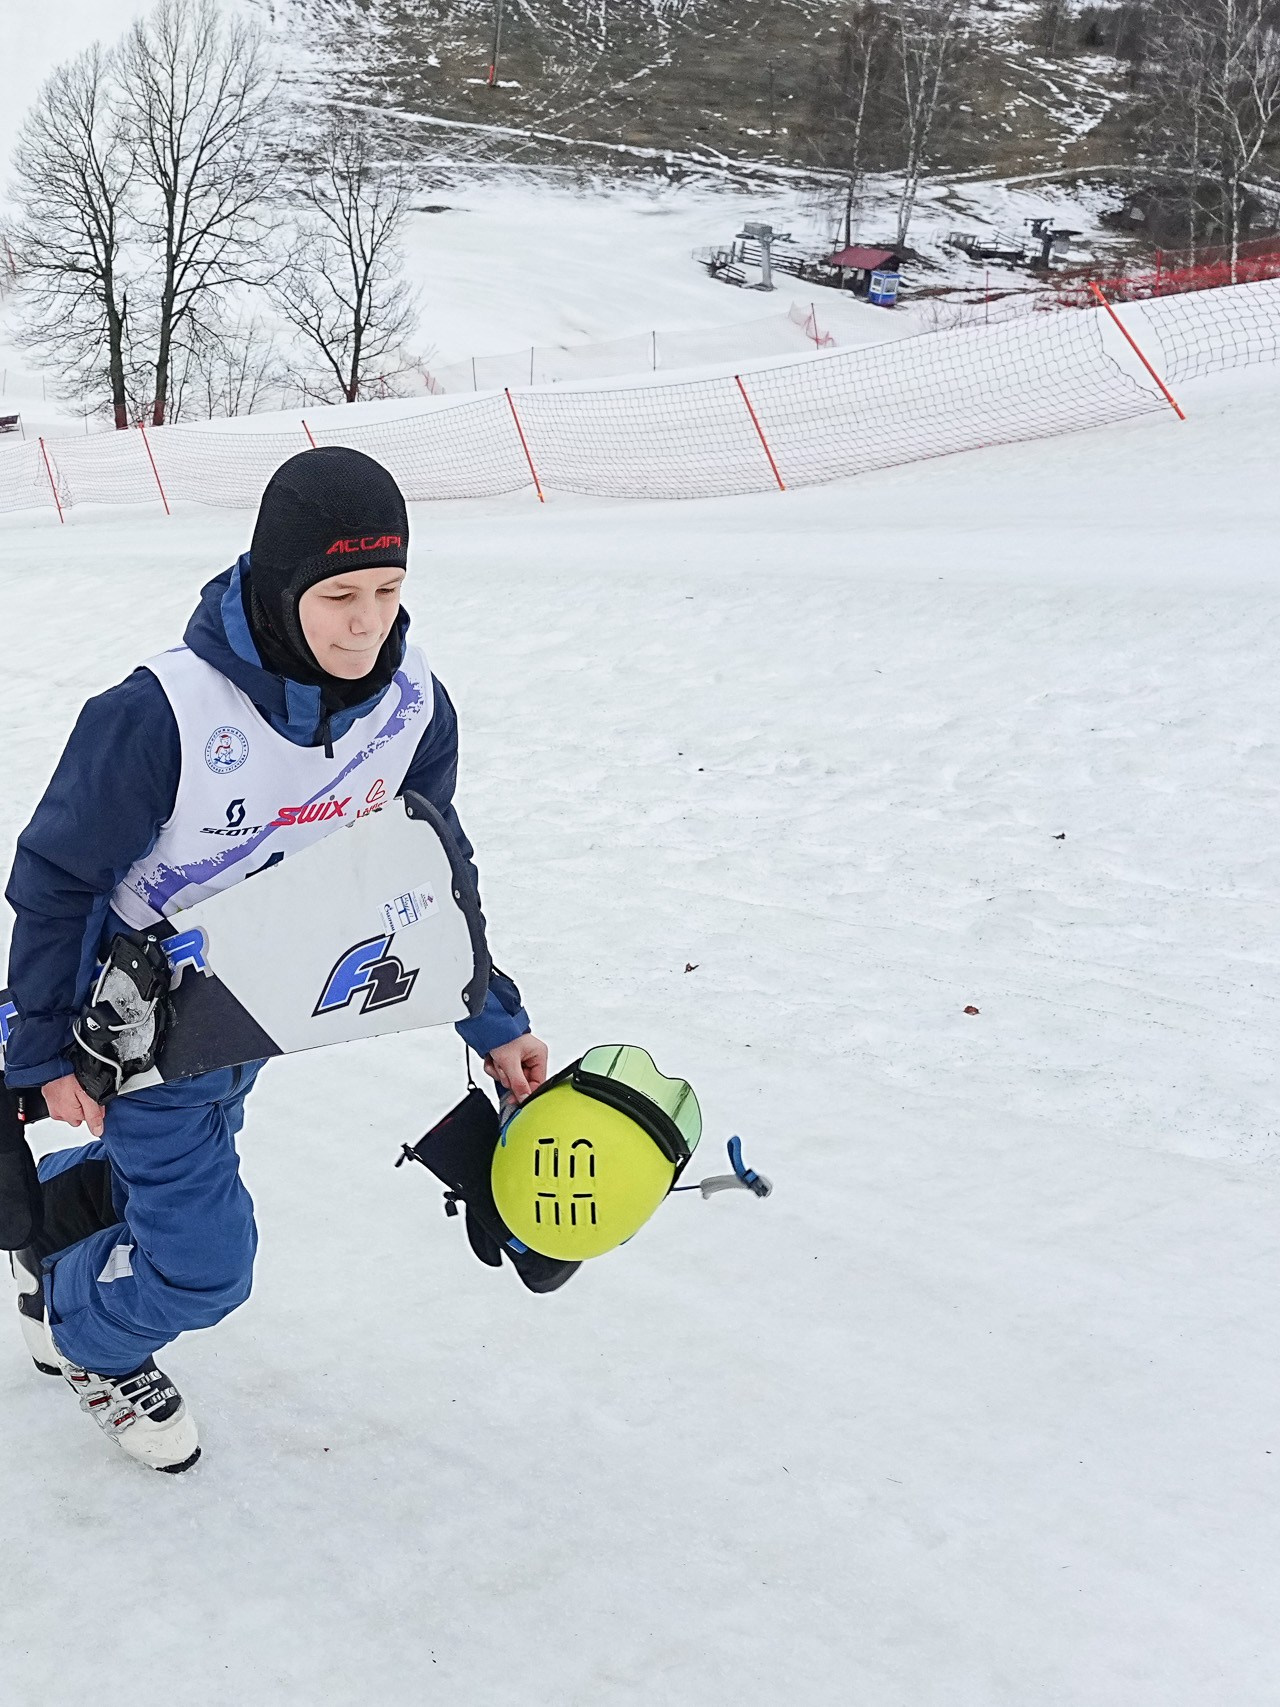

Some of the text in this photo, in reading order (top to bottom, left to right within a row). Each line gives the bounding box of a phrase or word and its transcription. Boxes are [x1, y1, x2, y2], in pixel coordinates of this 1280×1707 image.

[326, 535, 401, 554] ACCAPI
[200, 825, 263, 837] SCOTT
[311, 932, 420, 1017] F2
